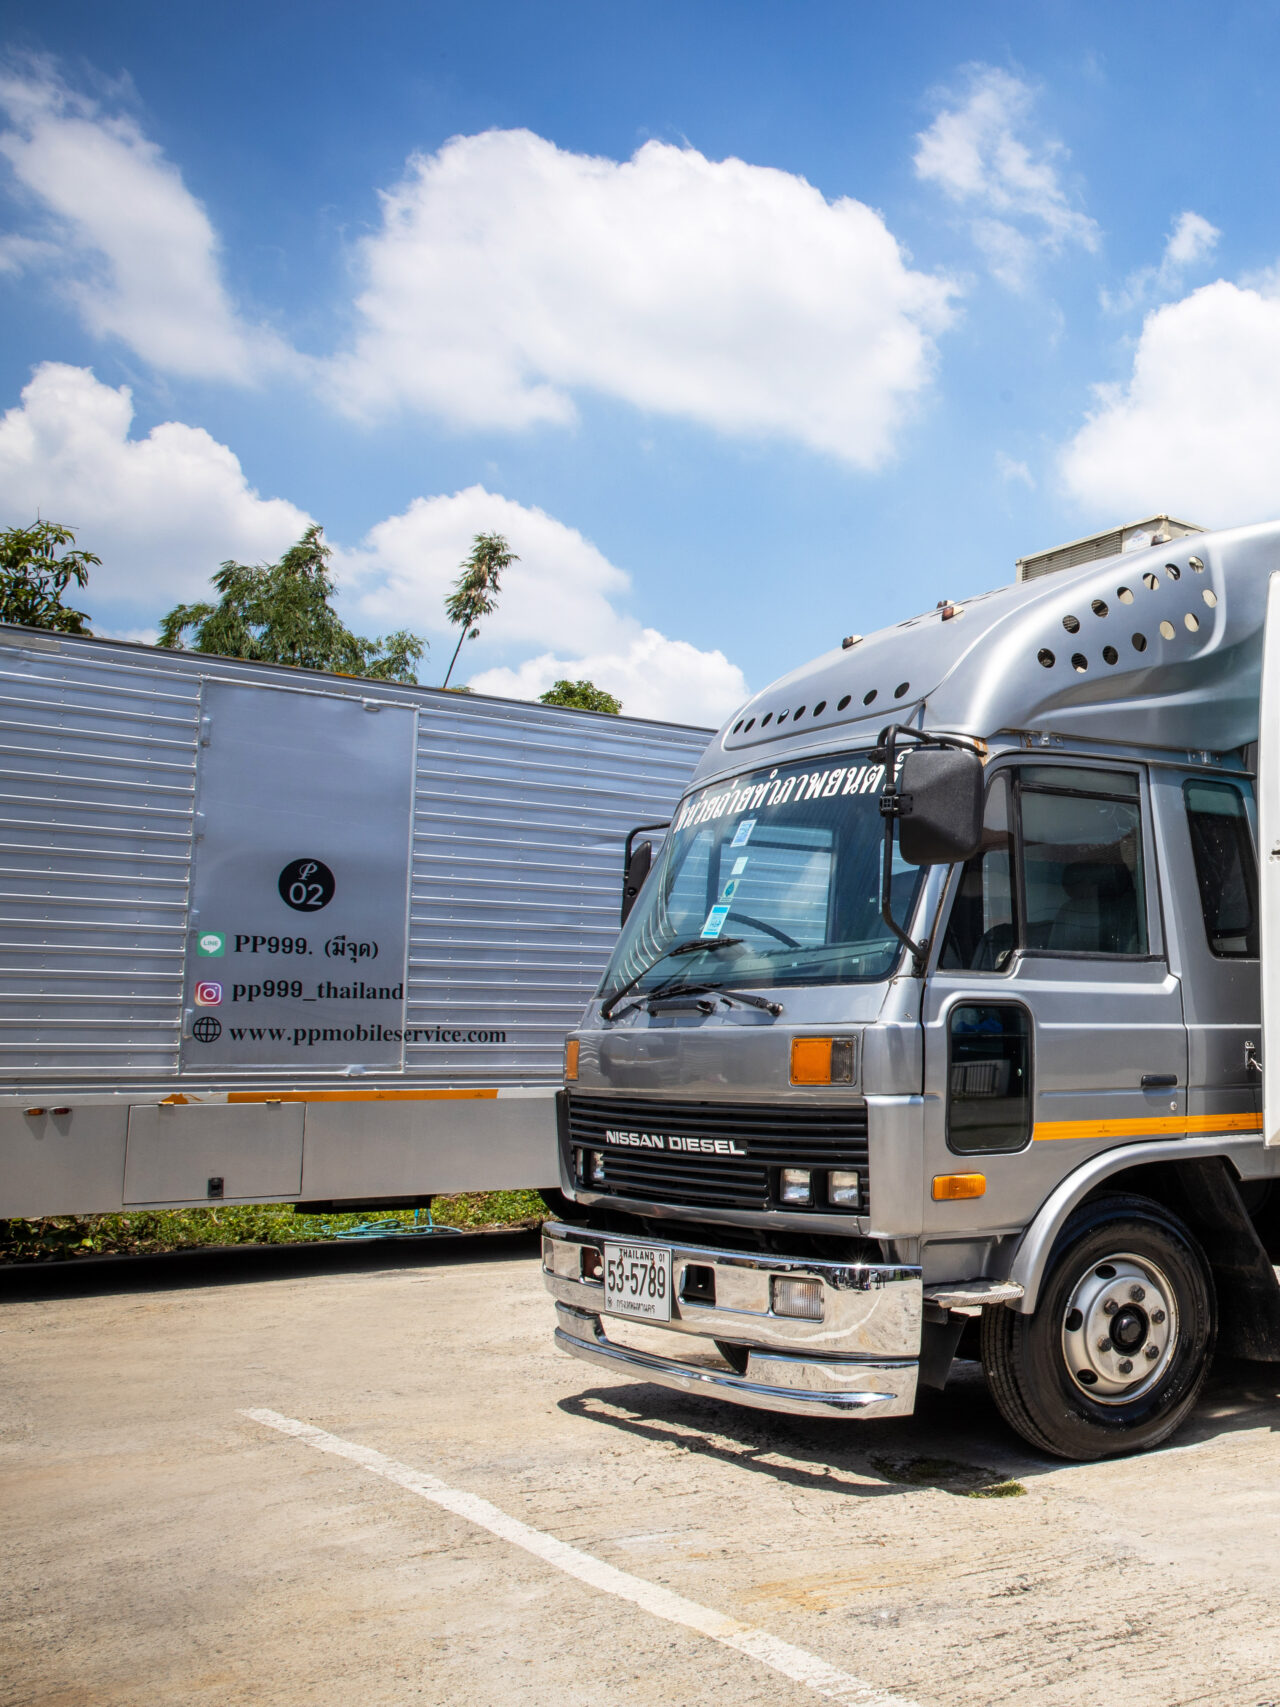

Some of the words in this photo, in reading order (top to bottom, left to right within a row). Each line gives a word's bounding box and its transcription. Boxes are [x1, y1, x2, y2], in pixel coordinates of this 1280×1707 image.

[289, 882, 323, 906] 02
[234, 934, 313, 956] PP999.
[231, 979, 405, 1002] pp999_thailand
[229, 1024, 507, 1046] www.ppmobileservice.com
[605, 1130, 664, 1149] NISSAN
[668, 1136, 746, 1156] DIESEL
[619, 1247, 655, 1261] THAILAND
[608, 1259, 666, 1299] 53-5789
